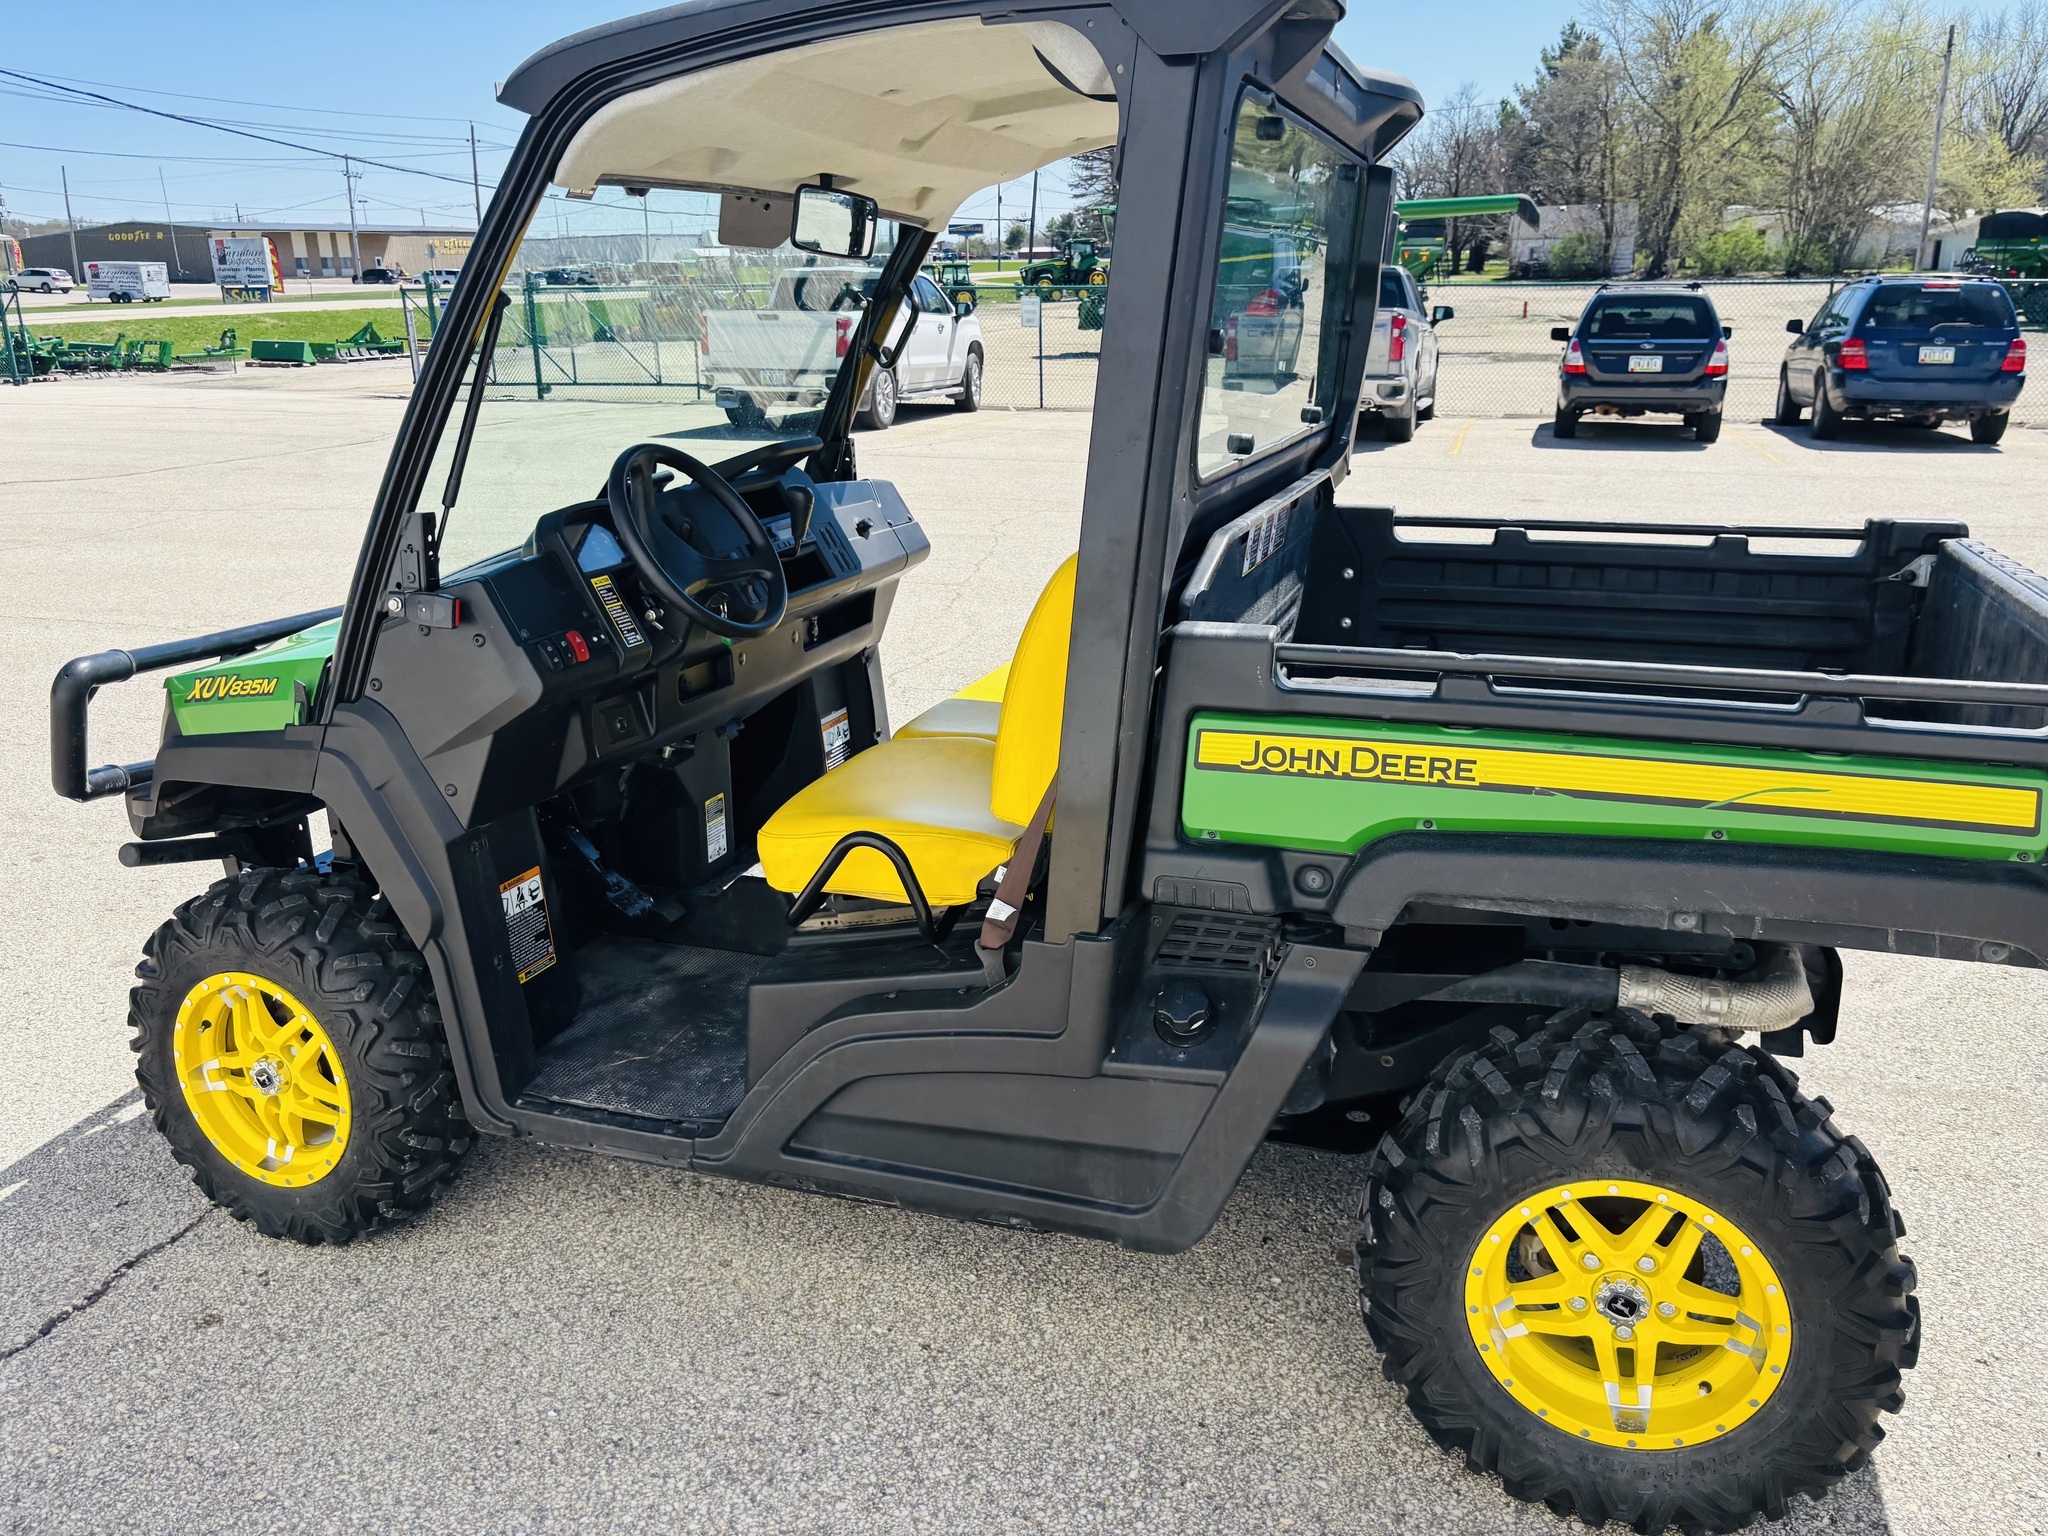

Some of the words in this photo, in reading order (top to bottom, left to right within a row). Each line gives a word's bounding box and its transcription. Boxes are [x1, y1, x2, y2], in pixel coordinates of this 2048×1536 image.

[227, 256, 266, 265] SHOWCASE
[231, 289, 261, 302] SALE
[186, 675, 279, 701] XUV835M
[1240, 740, 1340, 772] JOHN
[1350, 746, 1478, 782] DEERE
